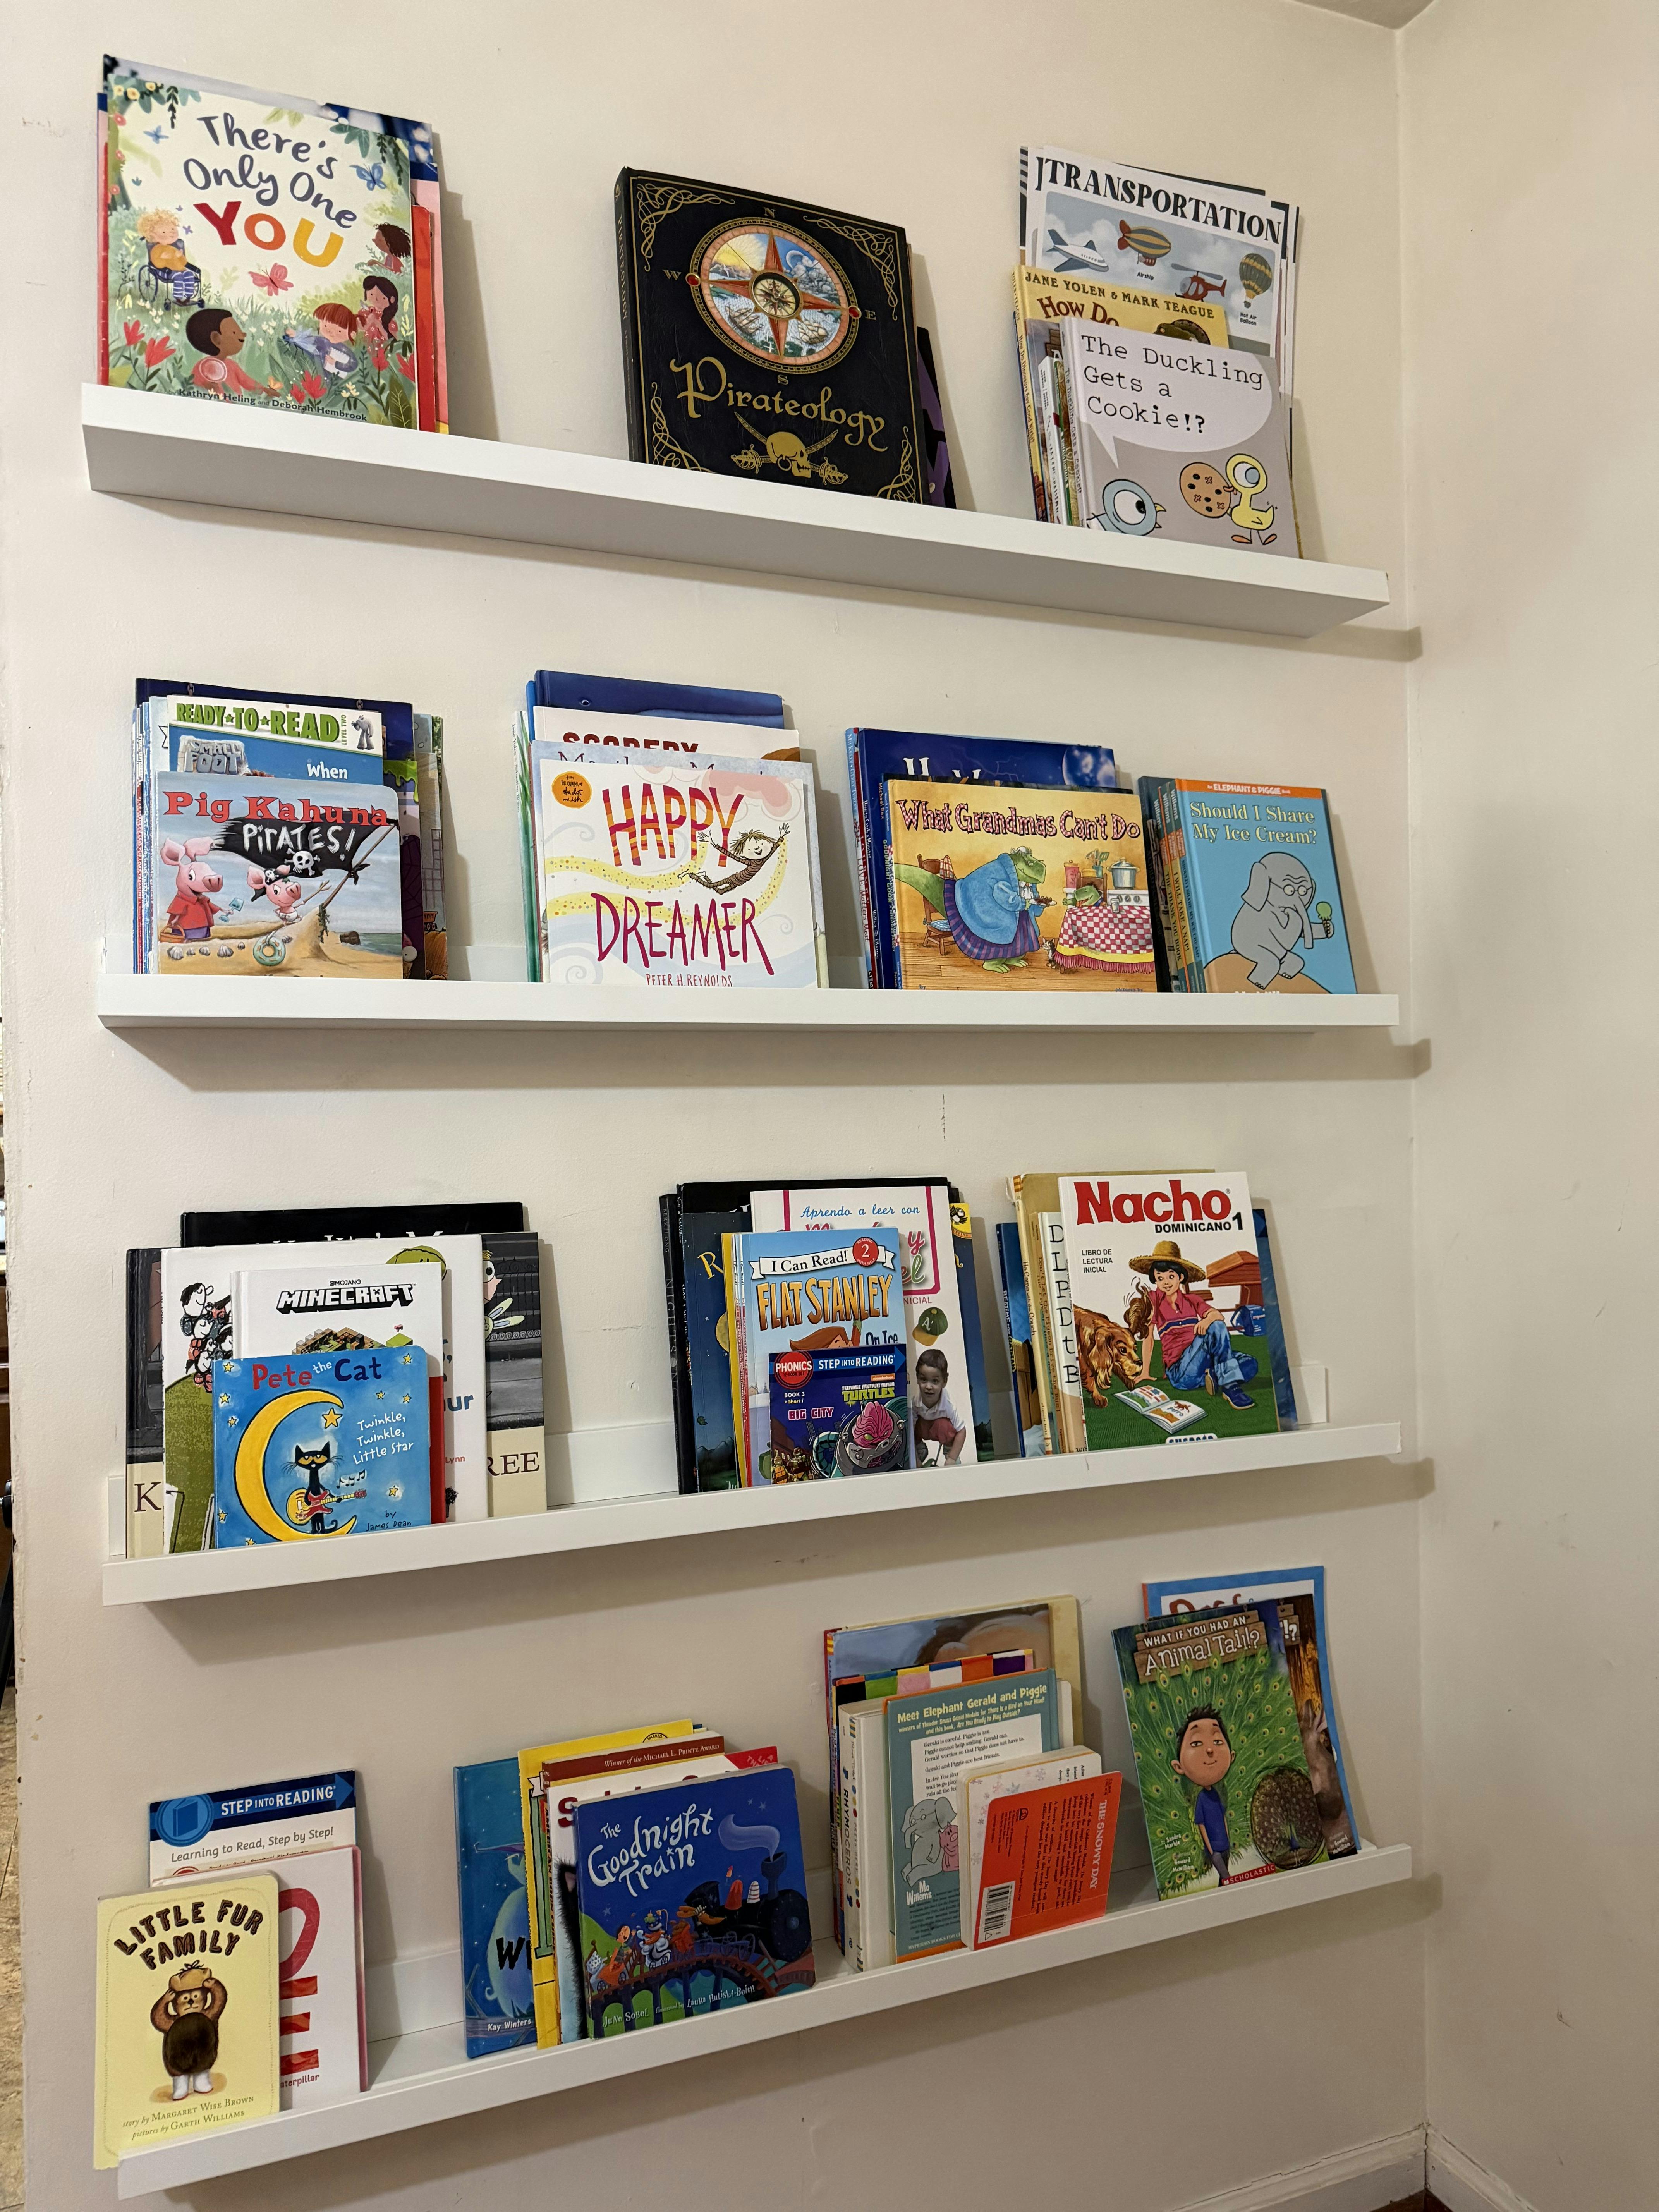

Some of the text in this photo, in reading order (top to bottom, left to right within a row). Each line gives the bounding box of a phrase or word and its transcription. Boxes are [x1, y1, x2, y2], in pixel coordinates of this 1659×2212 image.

[196, 112, 338, 179] There's
[183, 154, 357, 228] Only One
[1044, 158, 1281, 244] TRANSPORTATION
[763, 206, 776, 217] N
[193, 201, 344, 268] YOU
[663, 269, 682, 281] W
[1137, 271, 1155, 280] Airship
[1025, 271, 1215, 319] JANE YOLEN & MARK TEAGUE
[864, 310, 877, 321] E
[1037, 295, 1120, 327] How Do
[1081, 334, 1264, 391] The Duckling
[777, 374, 789, 385] S
[1084, 365, 1172, 398] Gets a
[179, 388, 220, 401] Kathryn
[223, 392, 256, 405] Heling
[271, 398, 314, 413] Deborah
[317, 405, 368, 422] Hembrook
[670, 356, 888, 452] Pirateology
[1087, 396, 1206, 435] Cookie!?
[176, 702, 340, 742] READY TO READ
[189, 740, 244, 756] SMALL
[184, 751, 238, 774] FOOT
[307, 761, 349, 780] When
[1212, 783, 1250, 793] ELEPHANT
[1258, 786, 1282, 795] PIGGIE
[162, 790, 390, 826] Pig Kahuna
[1189, 802, 1315, 824] Should I Share
[601, 783, 745, 868] HAPPY
[895, 799, 953, 833] What
[954, 803, 1058, 838] Grandmas
[1059, 810, 1109, 842] Can't
[1111, 813, 1141, 841] Do
[1192, 823, 1317, 845] My Ice Cream?
[590, 892, 775, 975] DREAMER
[646, 973, 673, 987] PETER
[800, 1204, 852, 1220] Aprendo
[872, 1204, 895, 1216] leer
[901, 1206, 920, 1215] con
[1073, 1179, 1231, 1225] Nacho
[1154, 1211, 1243, 1233] DOMINICANO 1
[771, 1250, 848, 1272] I Can Read!
[861, 1243, 871, 1259] 2
[276, 1283, 414, 1314] MINECRAFT
[756, 1274, 893, 1331] FLAT STANLEY
[252, 1357, 383, 1390] Pete the Cat
[775, 1360, 812, 1373] PHONICS
[818, 1358, 840, 1370] STEP
[855, 1355, 894, 1367] READING
[842, 1387, 895, 1402] TURTLES
[357, 1412, 406, 1431] Twinkle,
[788, 1407, 834, 1420] BIG CITY
[356, 1427, 405, 1447] Twinkle,
[352, 1441, 414, 1465] Little Star
[366, 1520, 412, 1532] James Dean
[385, 1510, 397, 1520] by
[1144, 1615, 1247, 1648] WHAT IF YOU HAD AN
[1144, 1638, 1212, 1676] Animal
[897, 1684, 1047, 1723] Meet Elephant Gerald and Piggie
[604, 1759, 625, 1768] Winner
[626, 1757, 634, 1766] of
[643, 1751, 670, 1762] MICHAEL
[678, 1746, 699, 1757] PRINTZ
[699, 1743, 720, 1753] AWARD
[221, 1786, 333, 1816] STEP INTO READING
[600, 1822, 622, 1839] The
[843, 1788, 852, 1885] RHYMOCEROS
[171, 1846, 219, 1863] Learning
[222, 1844, 233, 1854] to
[236, 1838, 265, 1852] Read,
[268, 1836, 290, 1846] Step
[294, 1831, 306, 1843] by
[308, 1826, 333, 1840] Step!
[588, 1803, 714, 1887] Goodnight
[1089, 1799, 1108, 1889] THE SNOWY DAY
[618, 1844, 696, 1897] Train
[1229, 1864, 1275, 1884] SCHOLASTIC
[906, 1890, 933, 1906] Willems
[919, 1880, 930, 1893] Mo
[114, 1899, 263, 1956] LITTLE FUR
[140, 1930, 240, 1970] FAMILY
[487, 2018, 532, 2032] Kay Winters
[122, 2119, 140, 2128] story
[141, 2116, 149, 2125] by
[132, 2128, 159, 2140] pictures
[160, 2126, 169, 2135] by
